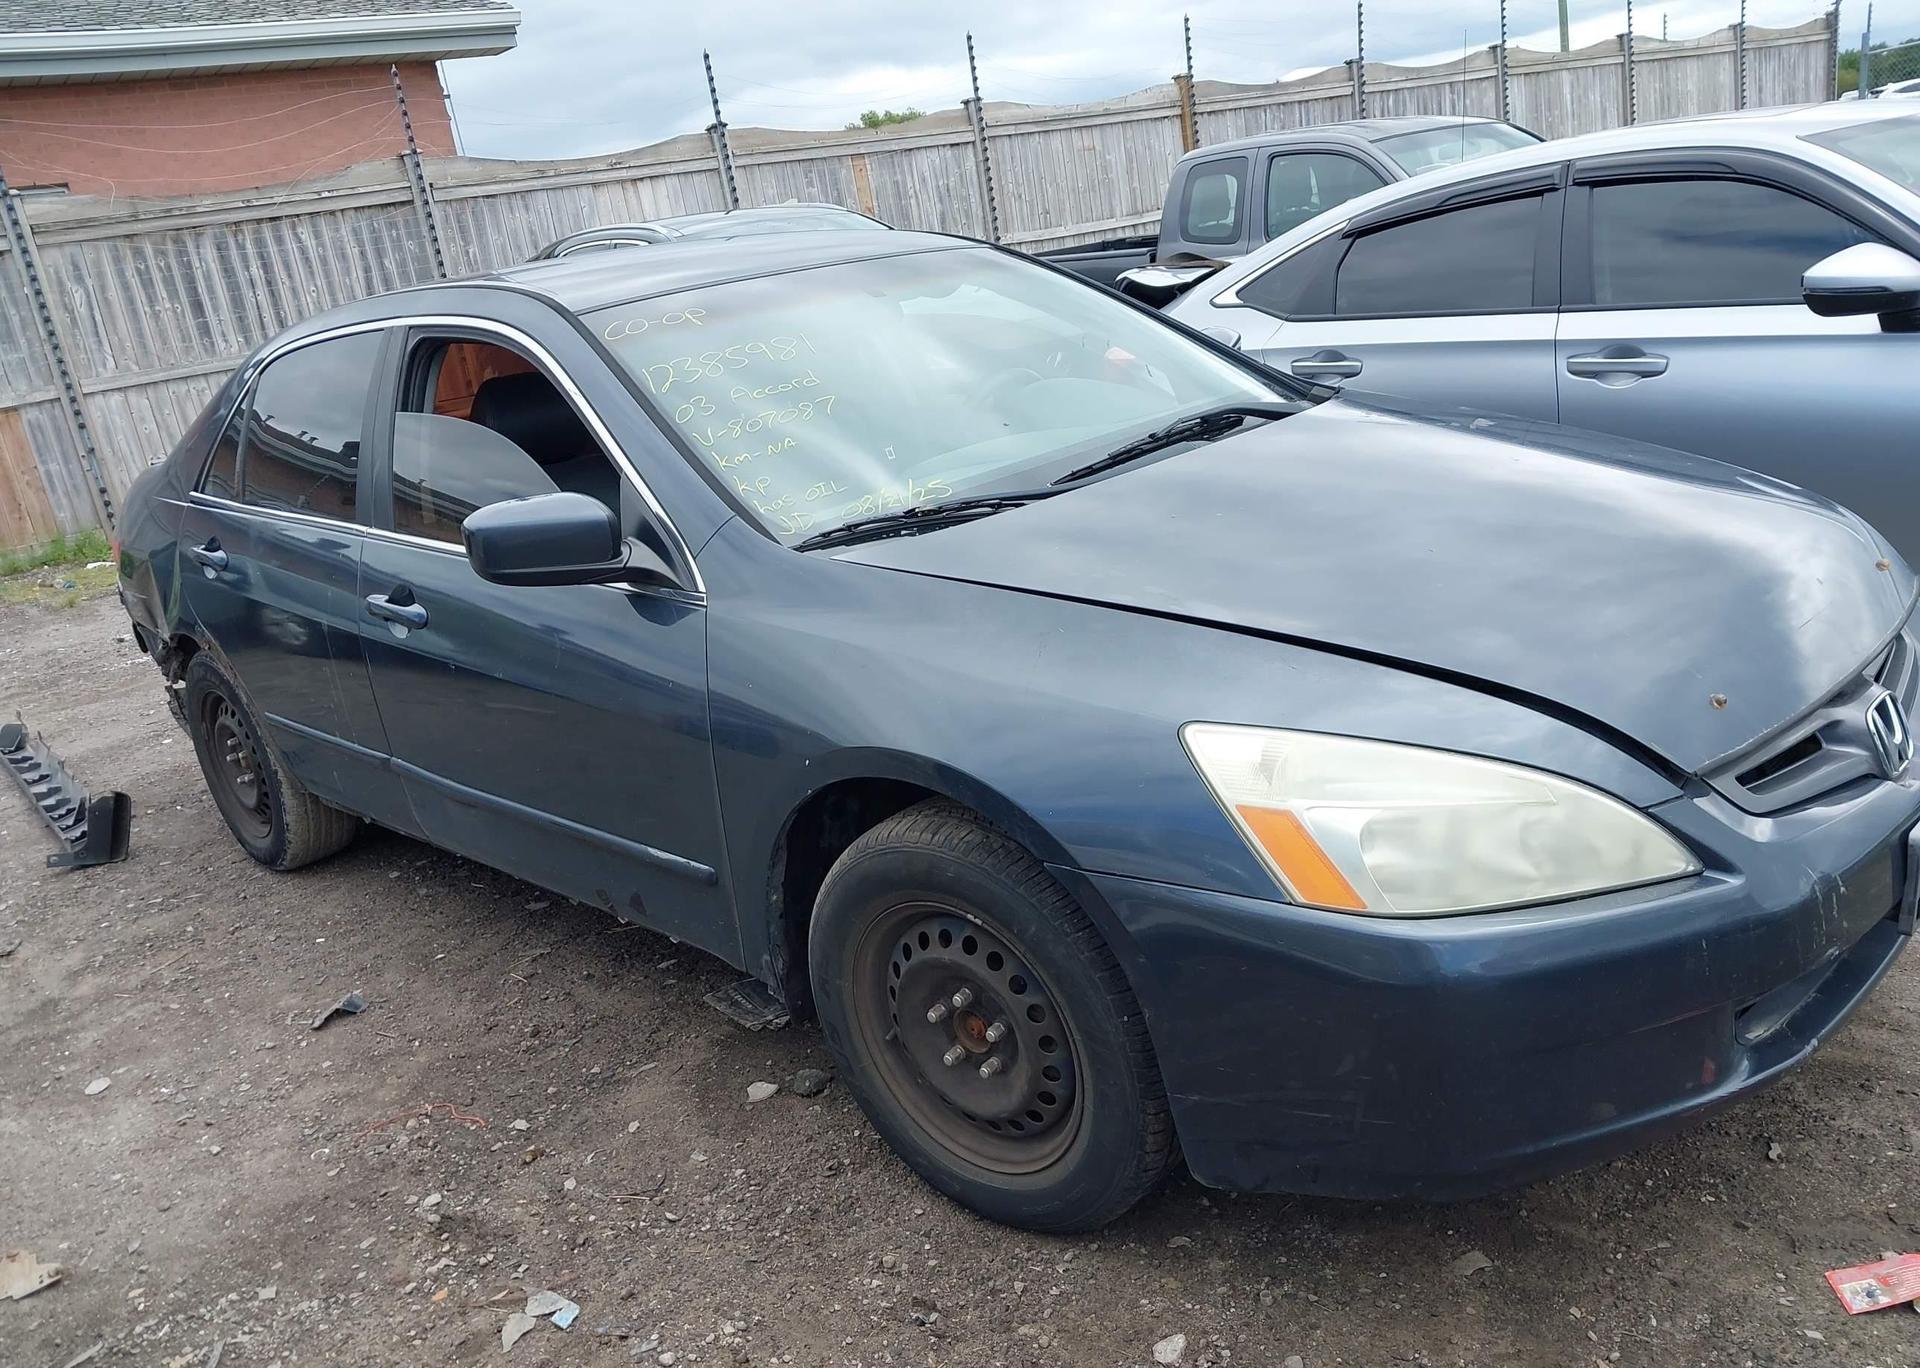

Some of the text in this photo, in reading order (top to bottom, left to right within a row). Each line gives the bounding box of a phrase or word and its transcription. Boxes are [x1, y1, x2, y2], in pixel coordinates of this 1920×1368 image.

[641, 332, 817, 394] 12385981
[675, 369, 821, 424] 03 Accord
[804, 480, 849, 502] OIL
